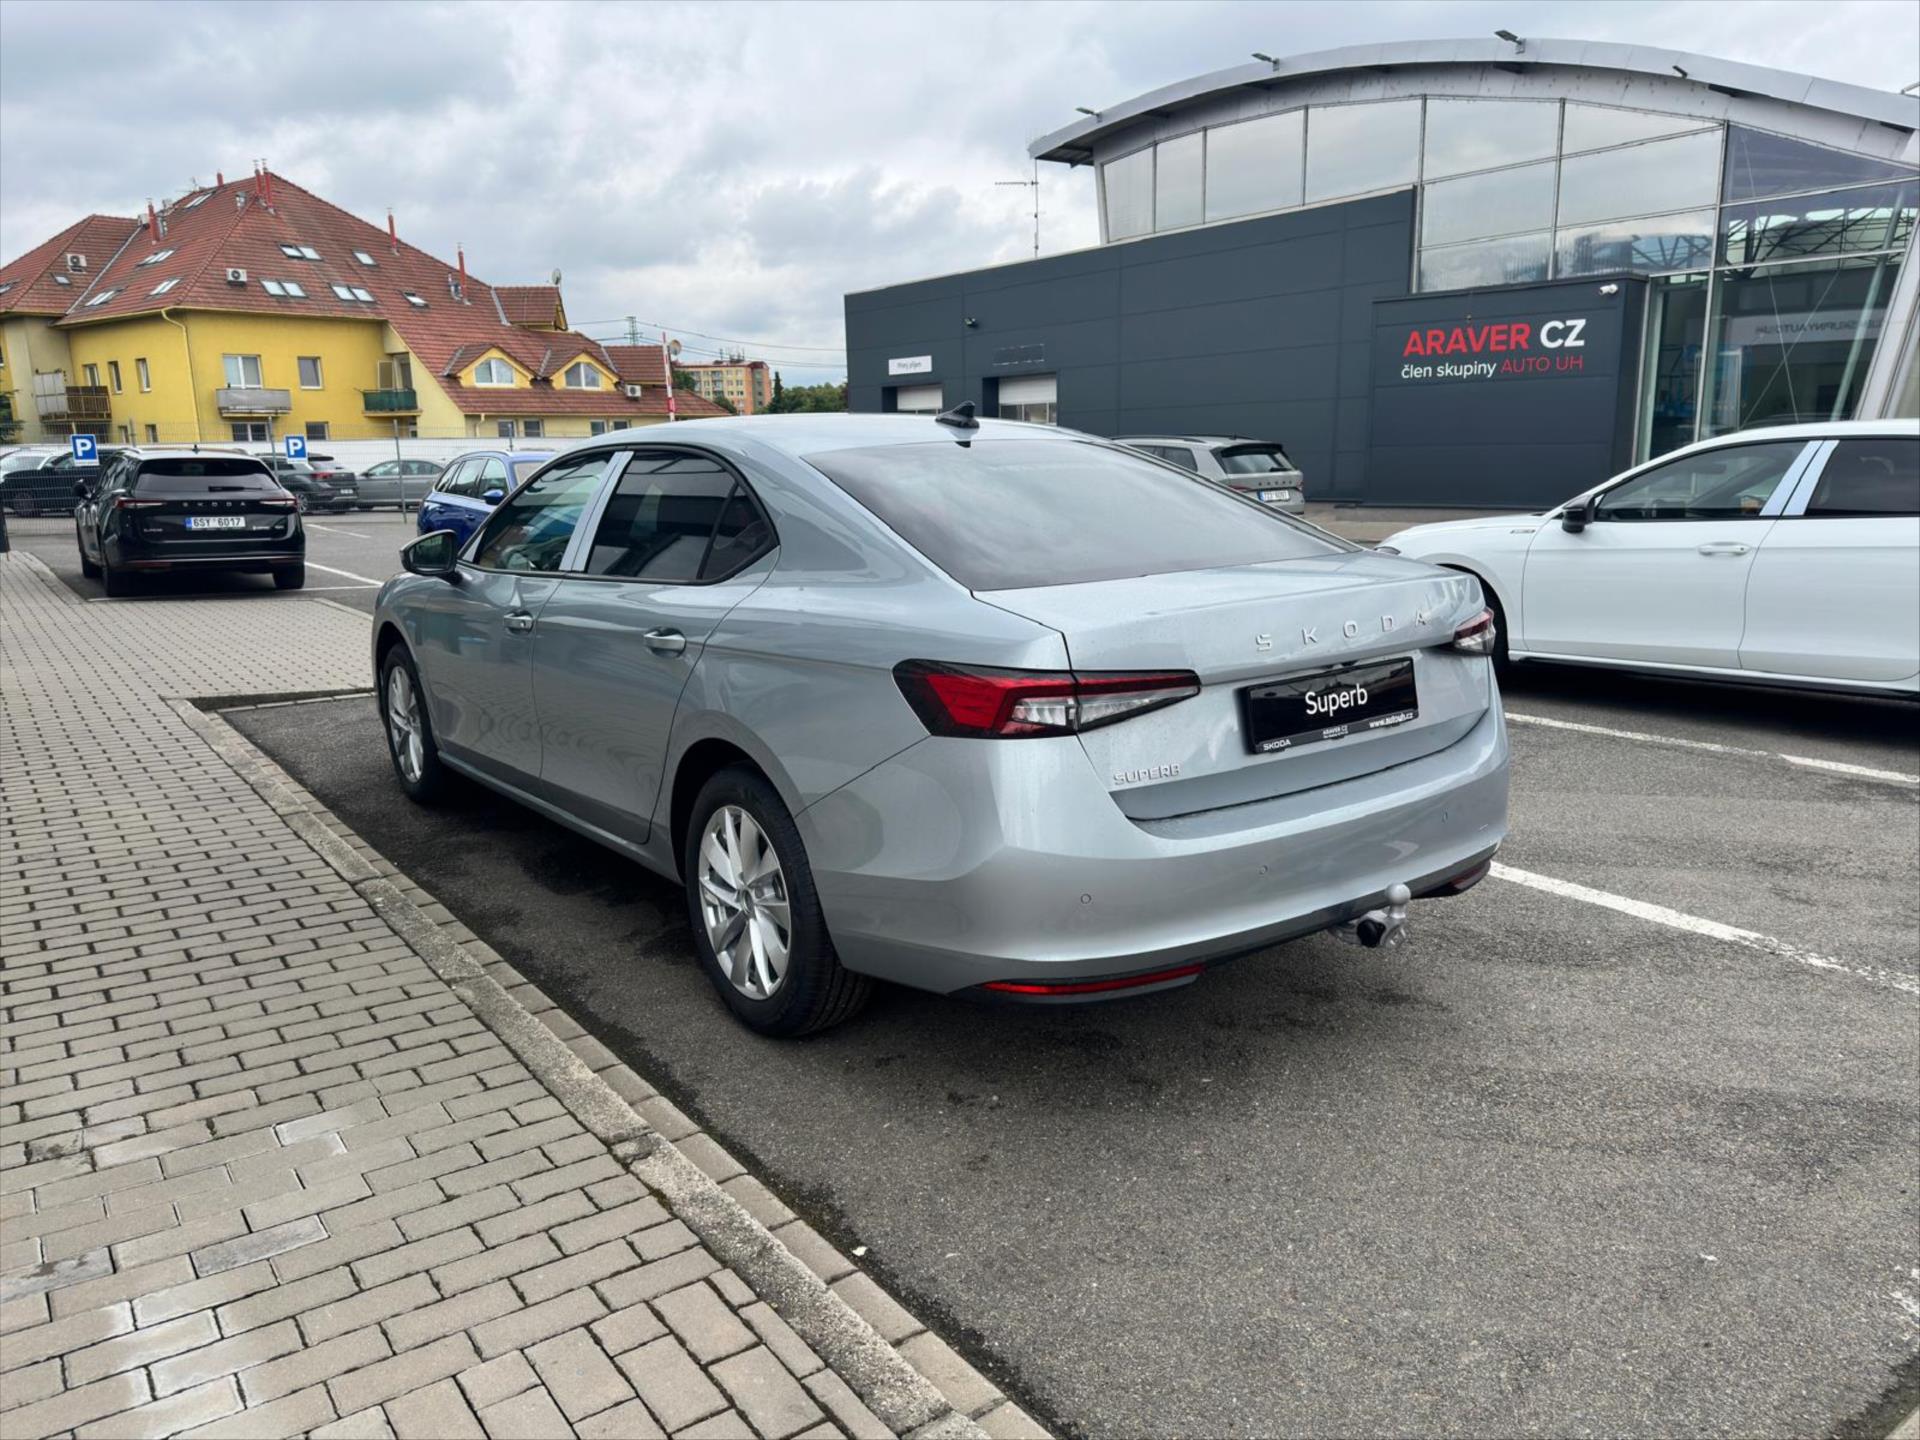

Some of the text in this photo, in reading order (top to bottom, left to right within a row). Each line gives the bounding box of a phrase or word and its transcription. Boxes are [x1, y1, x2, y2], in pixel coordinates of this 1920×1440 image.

[1403, 318, 1586, 357] ARAVER CZ
[1401, 355, 1583, 379] člen skupiny AUTO UH
[75, 438, 92, 457] P
[288, 438, 303, 456] P
[193, 517, 241, 528] 6SY 6017
[1304, 683, 1368, 718] Superb
[1113, 763, 1181, 785] SUPERB
